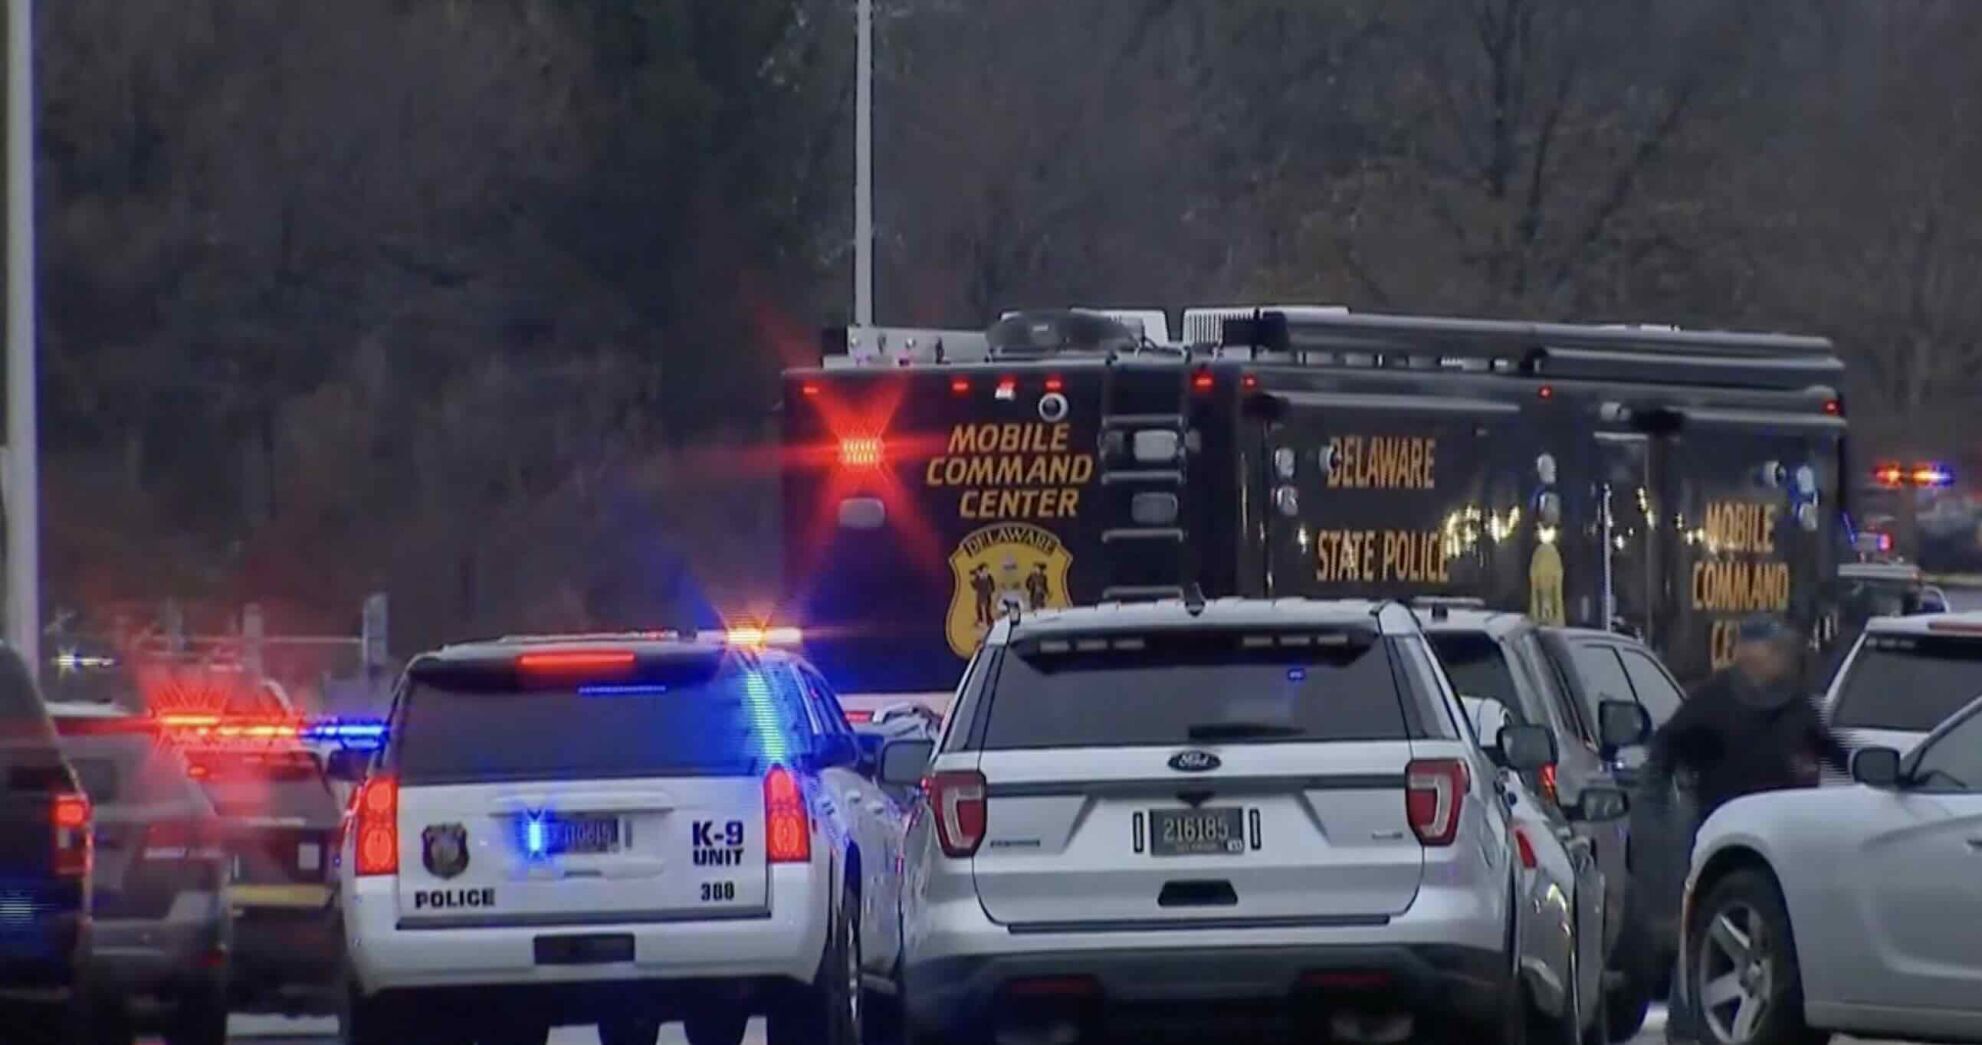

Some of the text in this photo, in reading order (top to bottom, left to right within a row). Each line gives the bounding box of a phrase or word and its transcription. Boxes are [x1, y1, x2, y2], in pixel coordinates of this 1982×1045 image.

[949, 424, 1069, 453] MOBILE
[927, 455, 1092, 485] COMMAND
[1327, 437, 1436, 488] DELAWARE
[960, 490, 1080, 517] CENTER
[965, 526, 1055, 555] DELAWARE
[1705, 503, 1775, 552] MOBILE
[1316, 529, 1450, 583] STATE POLICE
[1692, 561, 1789, 611] COMMAND
[692, 820, 744, 847] K-9
[1163, 816, 1229, 842] 216185
[693, 847, 745, 866] UNIT
[415, 887, 496, 909] POLICE
